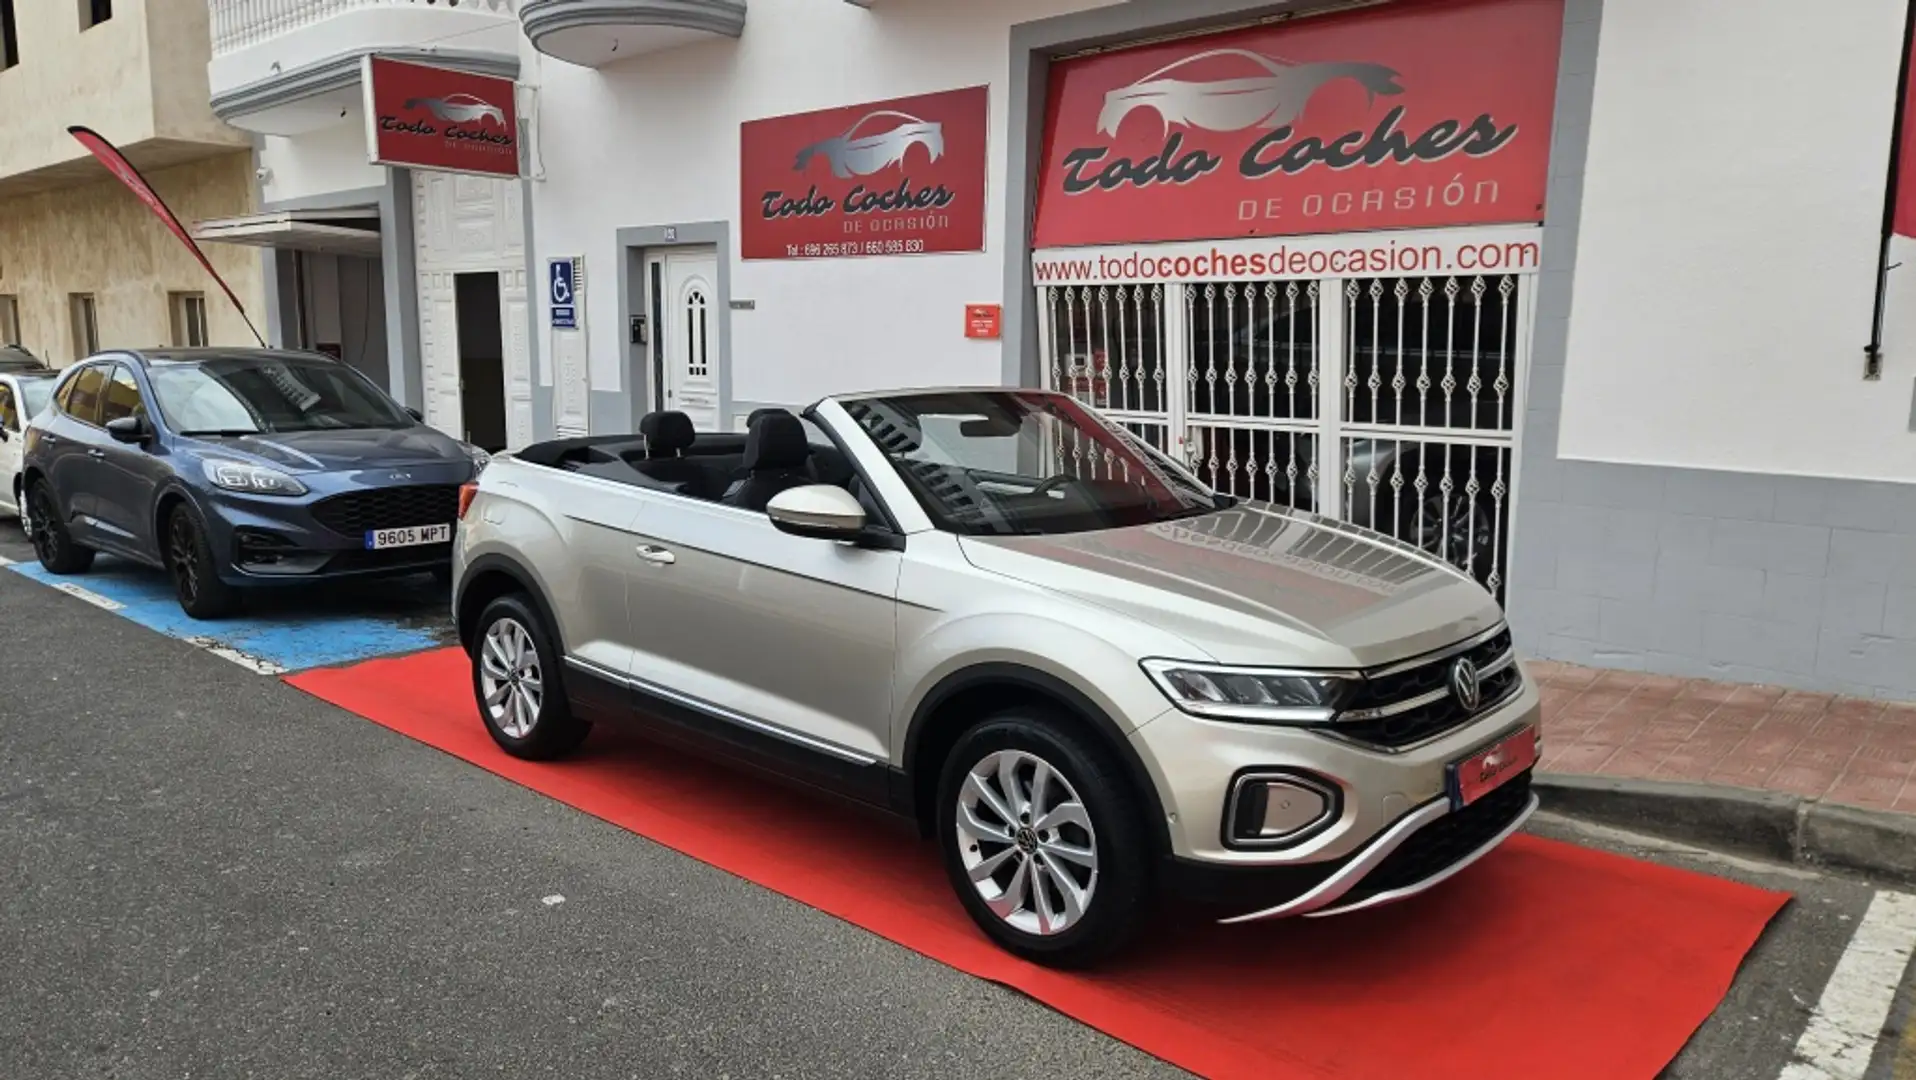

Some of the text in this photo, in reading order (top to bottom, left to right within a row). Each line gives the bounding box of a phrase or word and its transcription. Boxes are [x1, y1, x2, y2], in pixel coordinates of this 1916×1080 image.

[381, 117, 513, 146] Todo Coches
[1062, 104, 1519, 196] Todo Coches
[761, 176, 956, 219] Todo Coches
[1237, 172, 1500, 222] DE OCASIÓN
[843, 211, 949, 234] DE OCASIÓN
[1035, 239, 1539, 281] www.todocochesdeocasion.com
[377, 526, 447, 546] 9605 MPT
